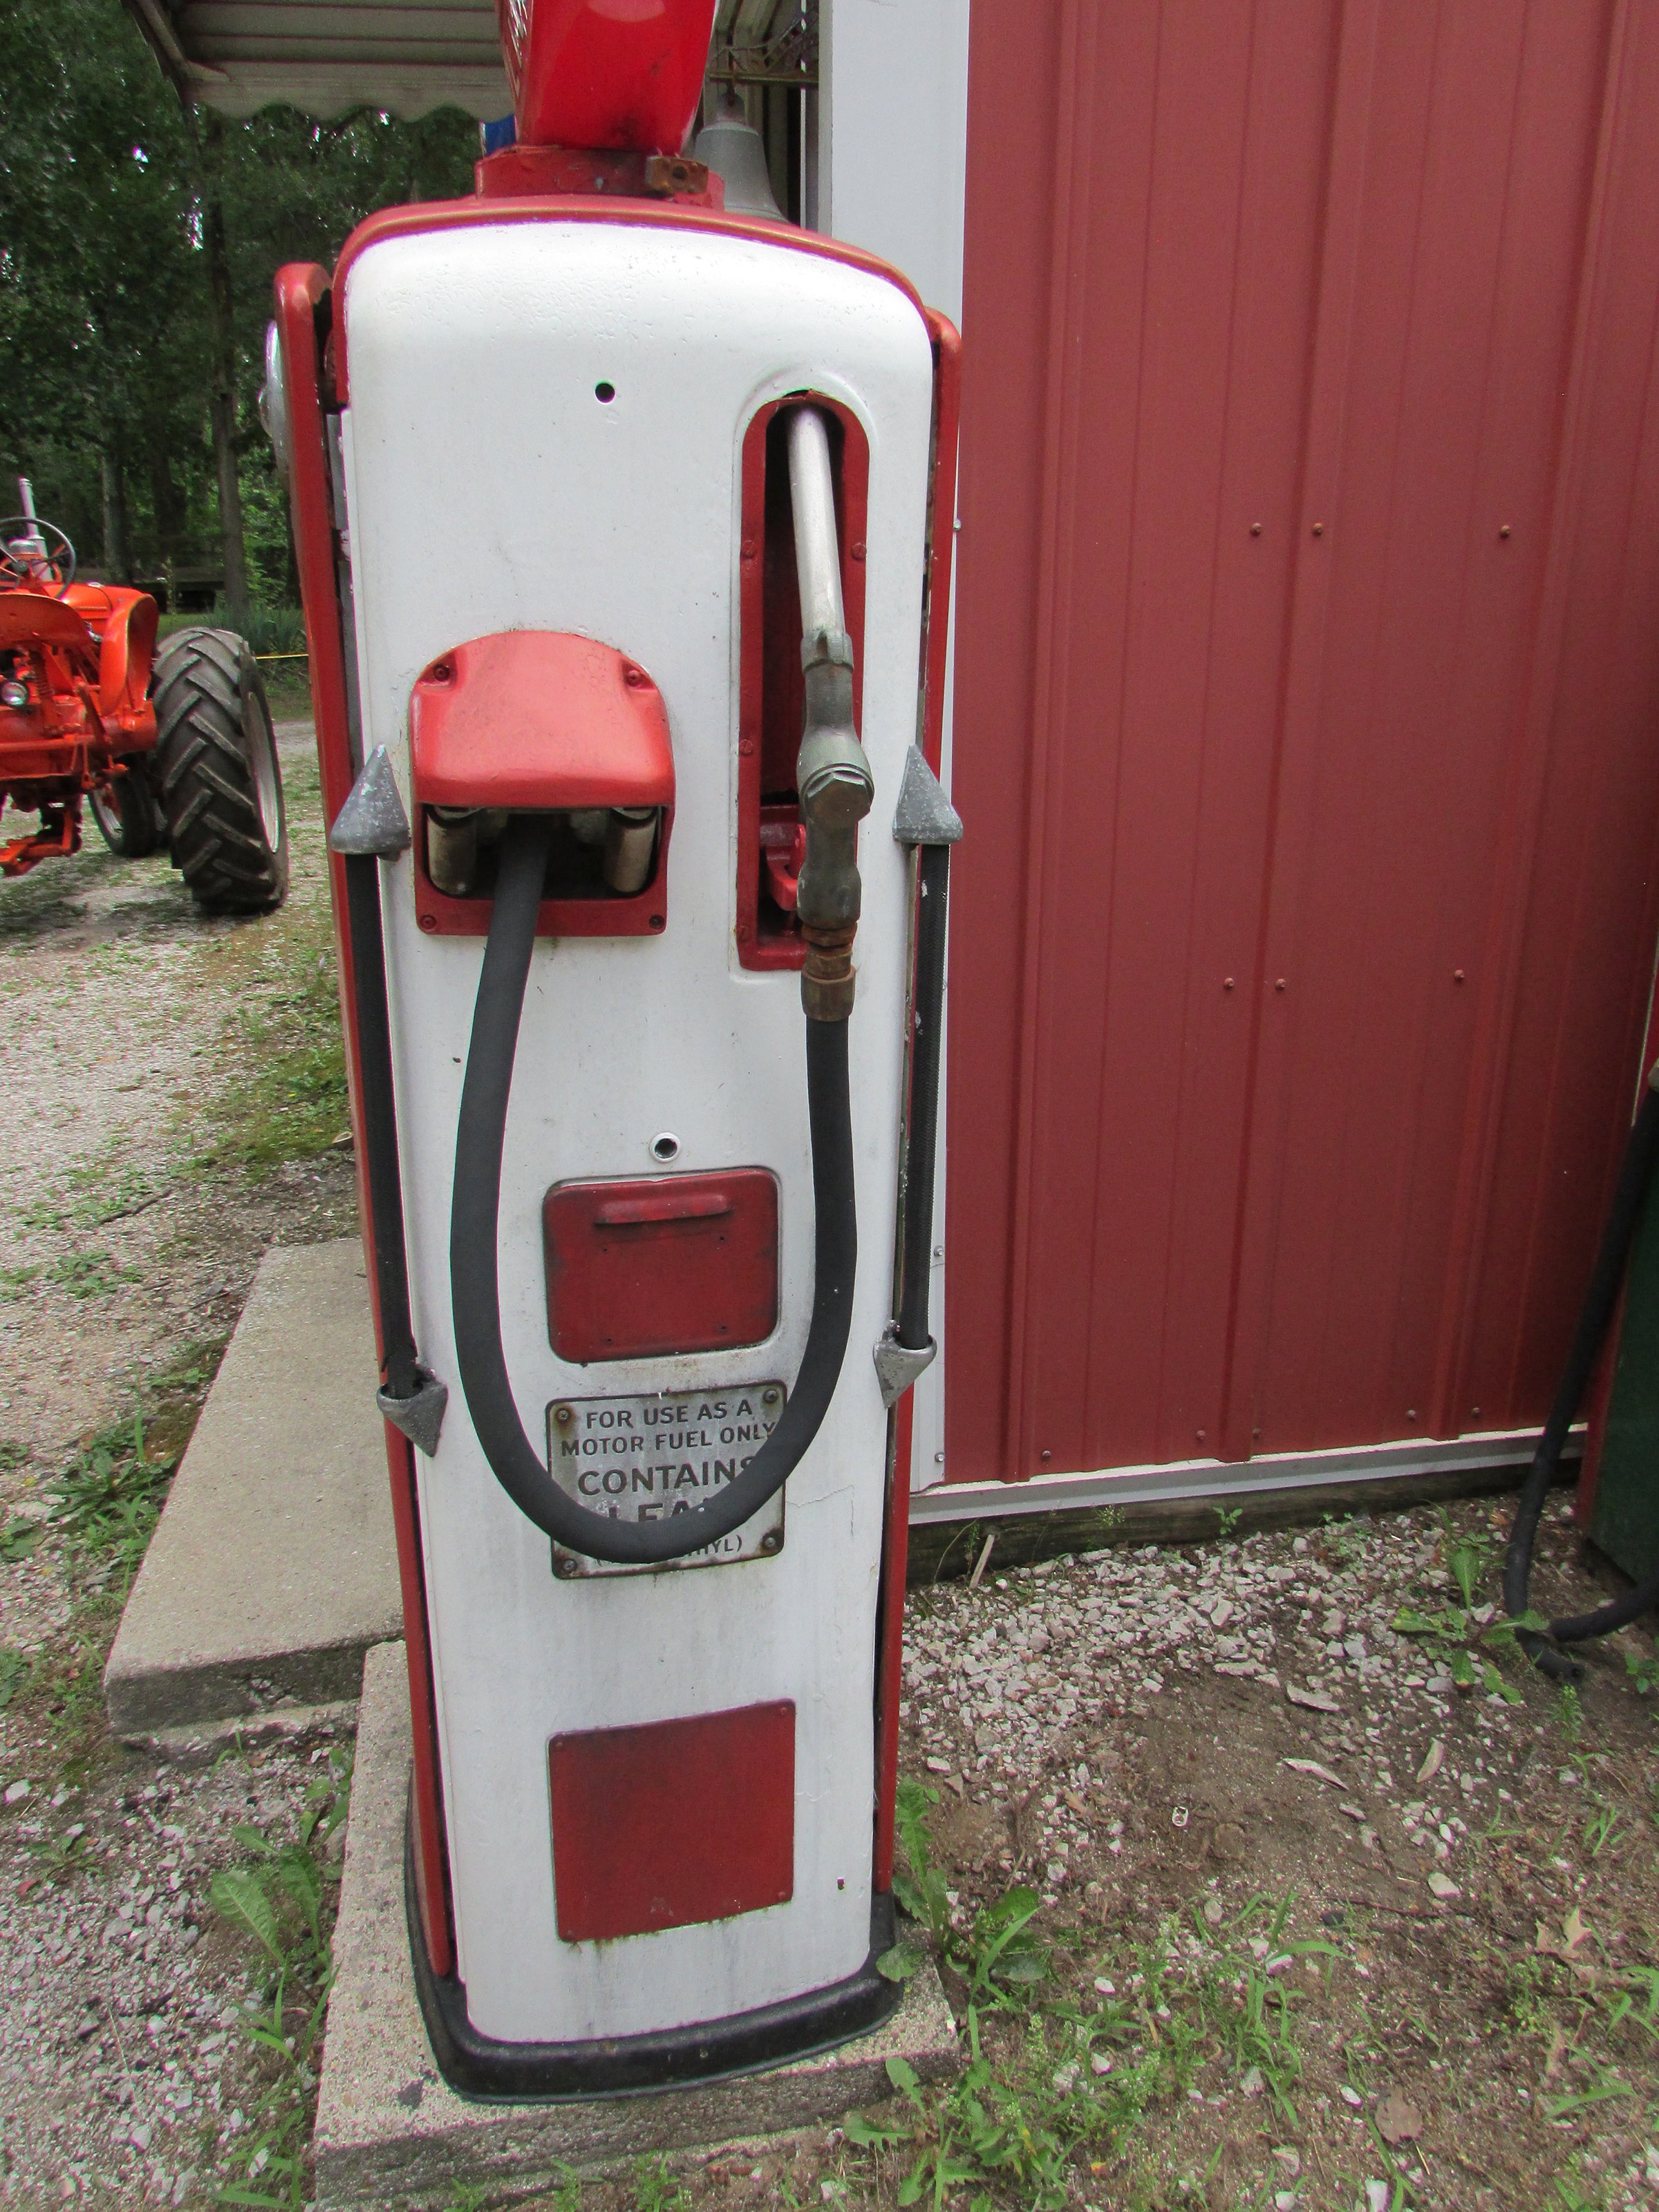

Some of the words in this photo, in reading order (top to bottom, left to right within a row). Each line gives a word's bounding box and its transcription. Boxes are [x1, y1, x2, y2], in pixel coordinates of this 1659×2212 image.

[586, 1409, 633, 1430] FOR
[643, 1405, 688, 1426] USE
[697, 1401, 728, 1421] AS
[736, 1399, 753, 1416] A
[561, 1436, 644, 1457] MOTOR
[655, 1430, 713, 1450] FUEL
[720, 1421, 776, 1444] ONLY
